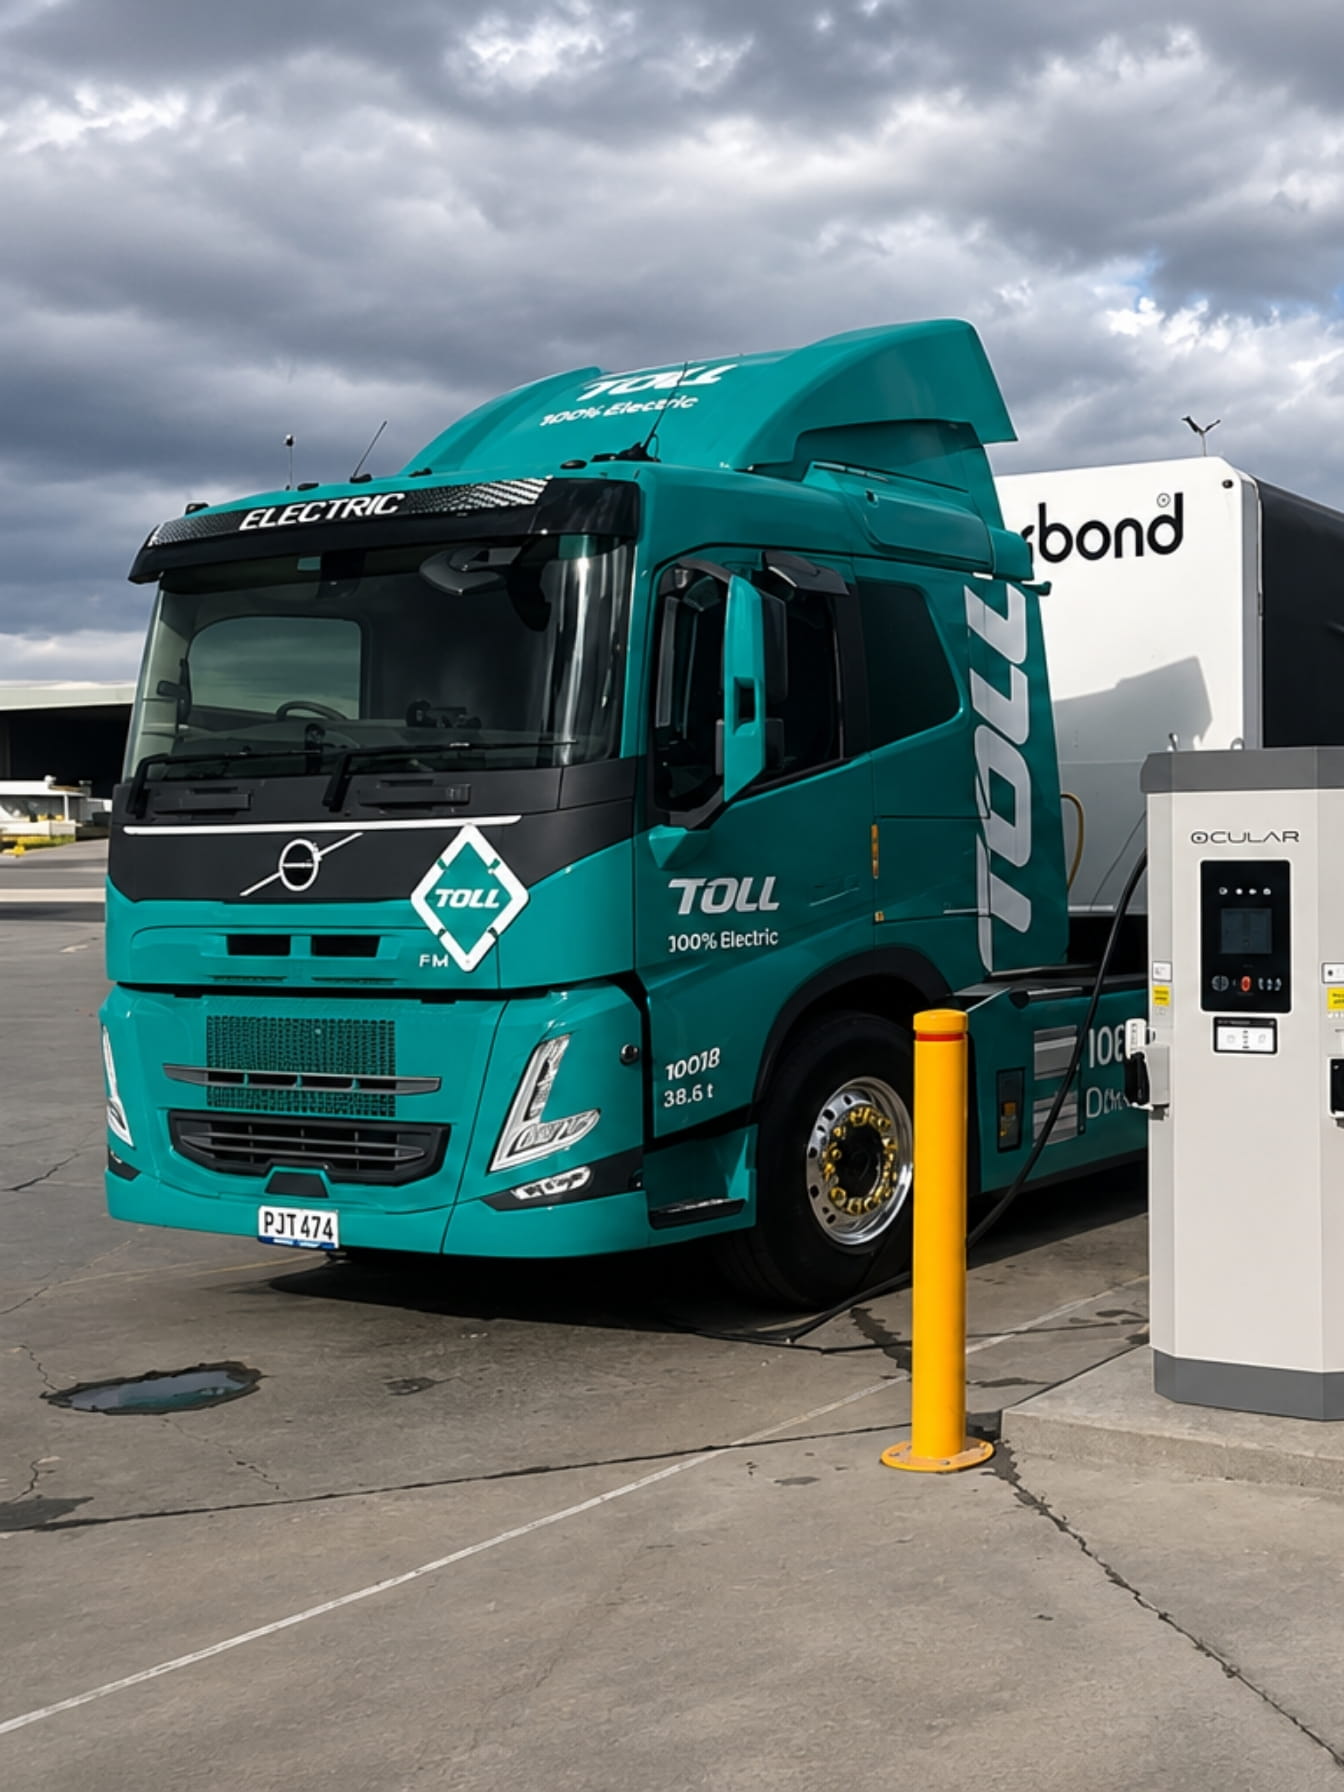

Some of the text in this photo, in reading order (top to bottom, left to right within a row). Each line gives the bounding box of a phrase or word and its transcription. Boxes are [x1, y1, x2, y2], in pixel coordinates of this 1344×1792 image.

[576, 364, 739, 402] TOLL
[603, 395, 699, 417] Electric
[239, 493, 406, 531] ELECTRIC
[964, 582, 1032, 973] TOLL
[1191, 831, 1300, 845] OCULAR
[435, 888, 500, 909] TOLL
[668, 876, 780, 916] TOLL
[668, 928, 779, 953] 100% Electric
[419, 953, 449, 968] FM
[665, 1047, 721, 1081] 10018
[663, 1084, 703, 1108] 38.6
